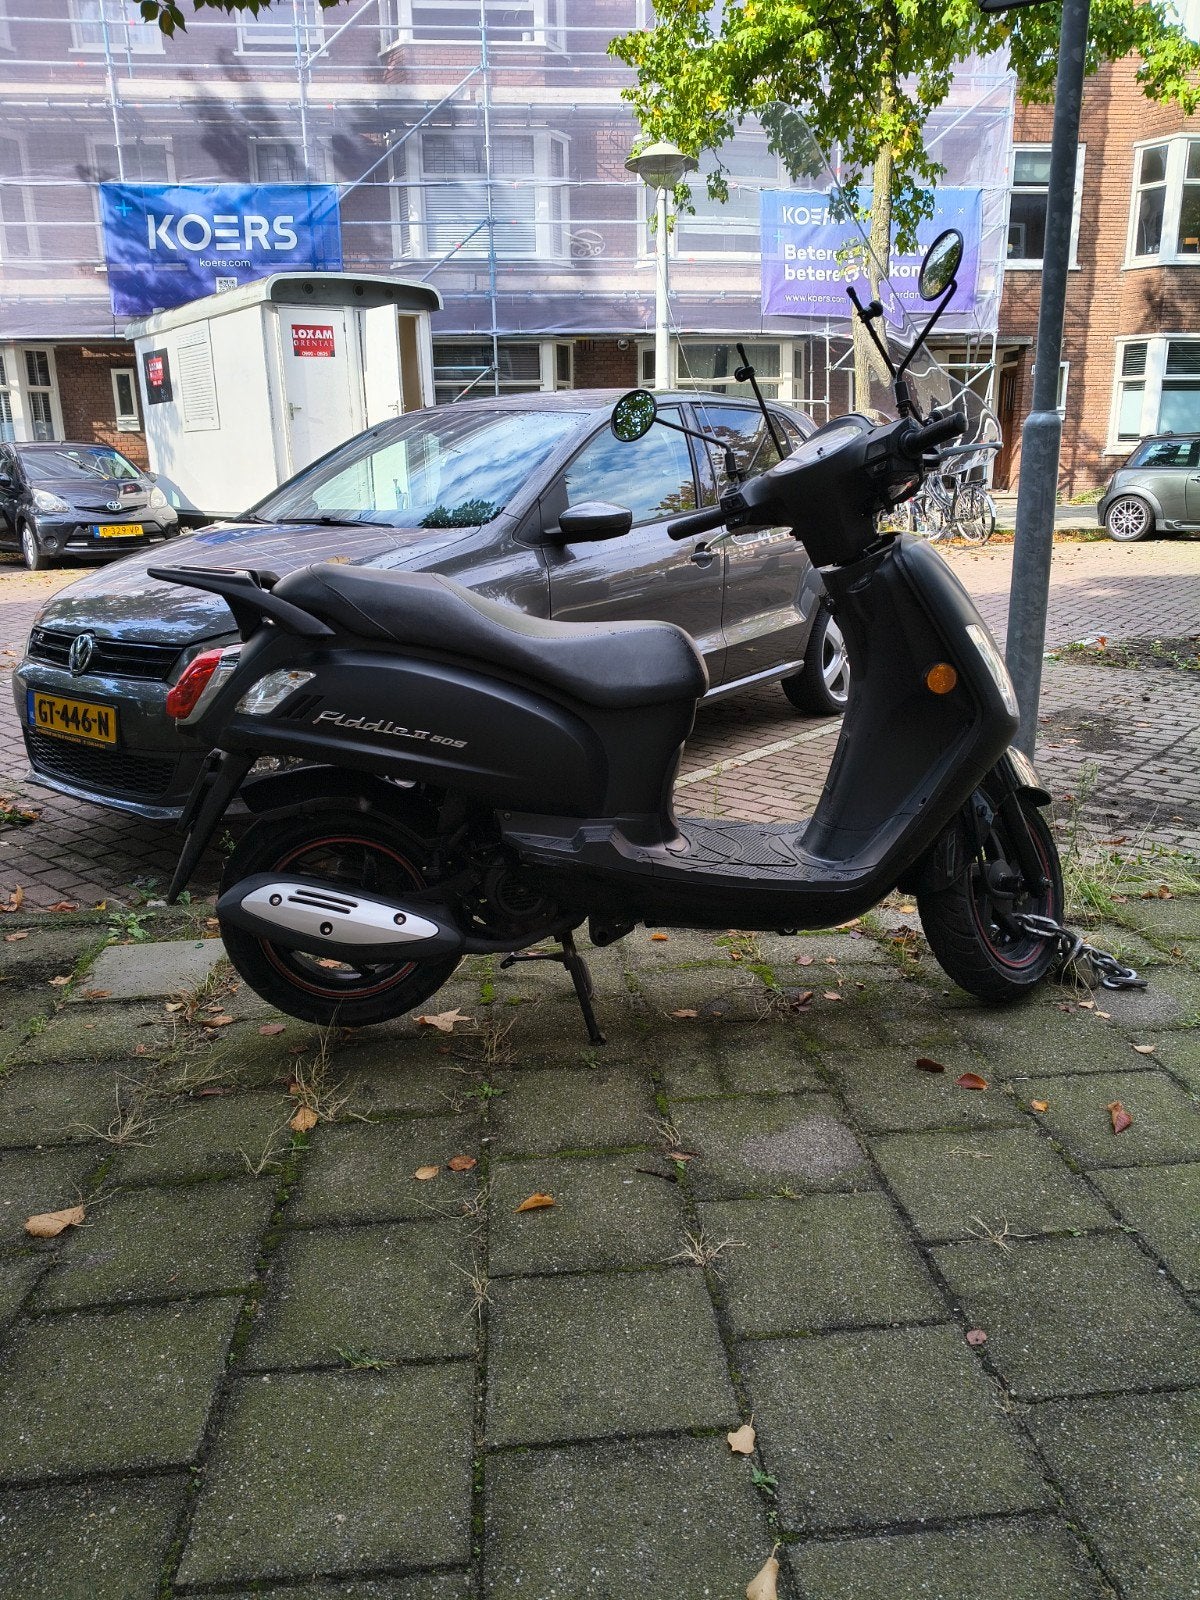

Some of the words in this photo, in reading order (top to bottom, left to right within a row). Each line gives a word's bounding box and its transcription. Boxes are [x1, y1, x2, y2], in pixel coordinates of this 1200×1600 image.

[147, 213, 298, 250] KOERS
[199, 258, 251, 268] koers.com
[784, 293, 847, 303] www.koers.com
[292, 328, 333, 339] LOXAM
[38, 698, 109, 737] GT-446-N
[312, 710, 414, 738] Fiddle
[429, 734, 468, 748] 50S
